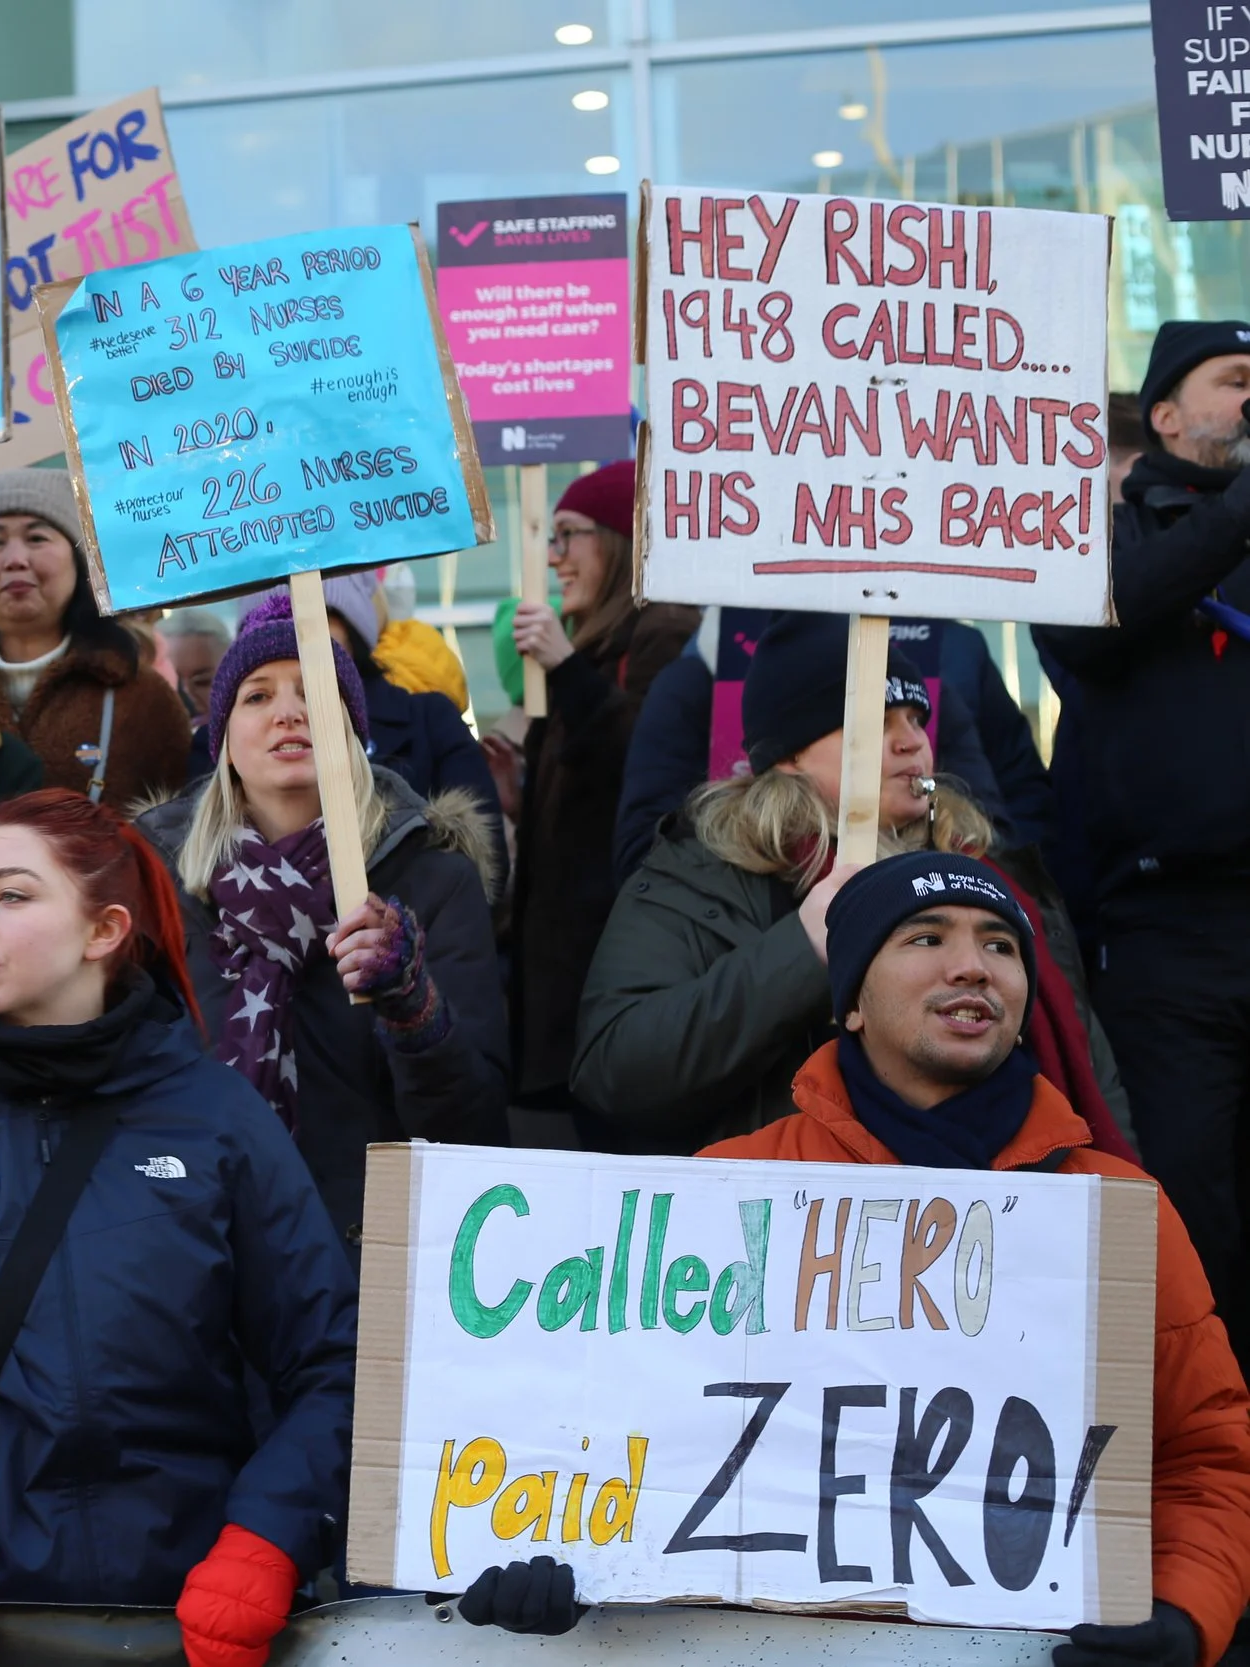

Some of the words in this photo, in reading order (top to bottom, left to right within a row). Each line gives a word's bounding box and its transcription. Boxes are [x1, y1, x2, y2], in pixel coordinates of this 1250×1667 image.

[1206, 6, 1233, 31] IF
[67, 109, 161, 202] FOR
[493, 218, 535, 234] SAFE
[537, 214, 616, 232] STAFFING
[494, 231, 544, 247] SAVES
[548, 229, 591, 244] LIVES
[664, 194, 800, 284] HEY
[824, 198, 998, 296] RISHI,
[92, 291, 123, 323] IN
[141, 281, 161, 311] A
[180, 273, 204, 302] 6
[219, 257, 289, 297] YEAR
[302, 246, 381, 280] PERIOD
[475, 285, 512, 303] Will
[516, 283, 564, 301] there
[567, 282, 590, 299] be
[165, 307, 222, 351] 312
[249, 295, 344, 335] NURSES
[450, 304, 517, 324] enough
[520, 301, 564, 320] staff
[565, 301, 617, 317] when
[467, 326, 500, 344] you
[504, 321, 549, 339] need
[551, 319, 599, 336] care?
[663, 288, 796, 364] 1948
[106, 342, 140, 360] better
[130, 366, 194, 402] DIED
[213, 352, 246, 379] BY
[269, 335, 363, 367] SUICIDE
[524, 357, 613, 375] shortages
[348, 382, 397, 403] enough
[492, 377, 530, 395] cost
[533, 375, 575, 392] lives
[671, 377, 882, 459] BEVAN
[895, 388, 1107, 470] WANTS
[118, 435, 154, 470] IN
[202, 463, 282, 520] 226
[300, 446, 418, 491] NURSES
[132, 504, 172, 523] nurses
[664, 468, 760, 541] HIS
[792, 481, 914, 550] NHS
[940, 477, 1093, 556] BACK!
[157, 504, 334, 578] ATTEMPTED
[350, 486, 450, 530] SUICIDE
[948, 873, 975, 883] Royal
[950, 881, 961, 889] of
[134, 1164, 165, 1172] NORTH
[147, 1156, 167, 1165] THE
[448, 1183, 773, 1339] Called
[431, 1430, 649, 1579] paid
[662, 1382, 1118, 1594] ZERO!
